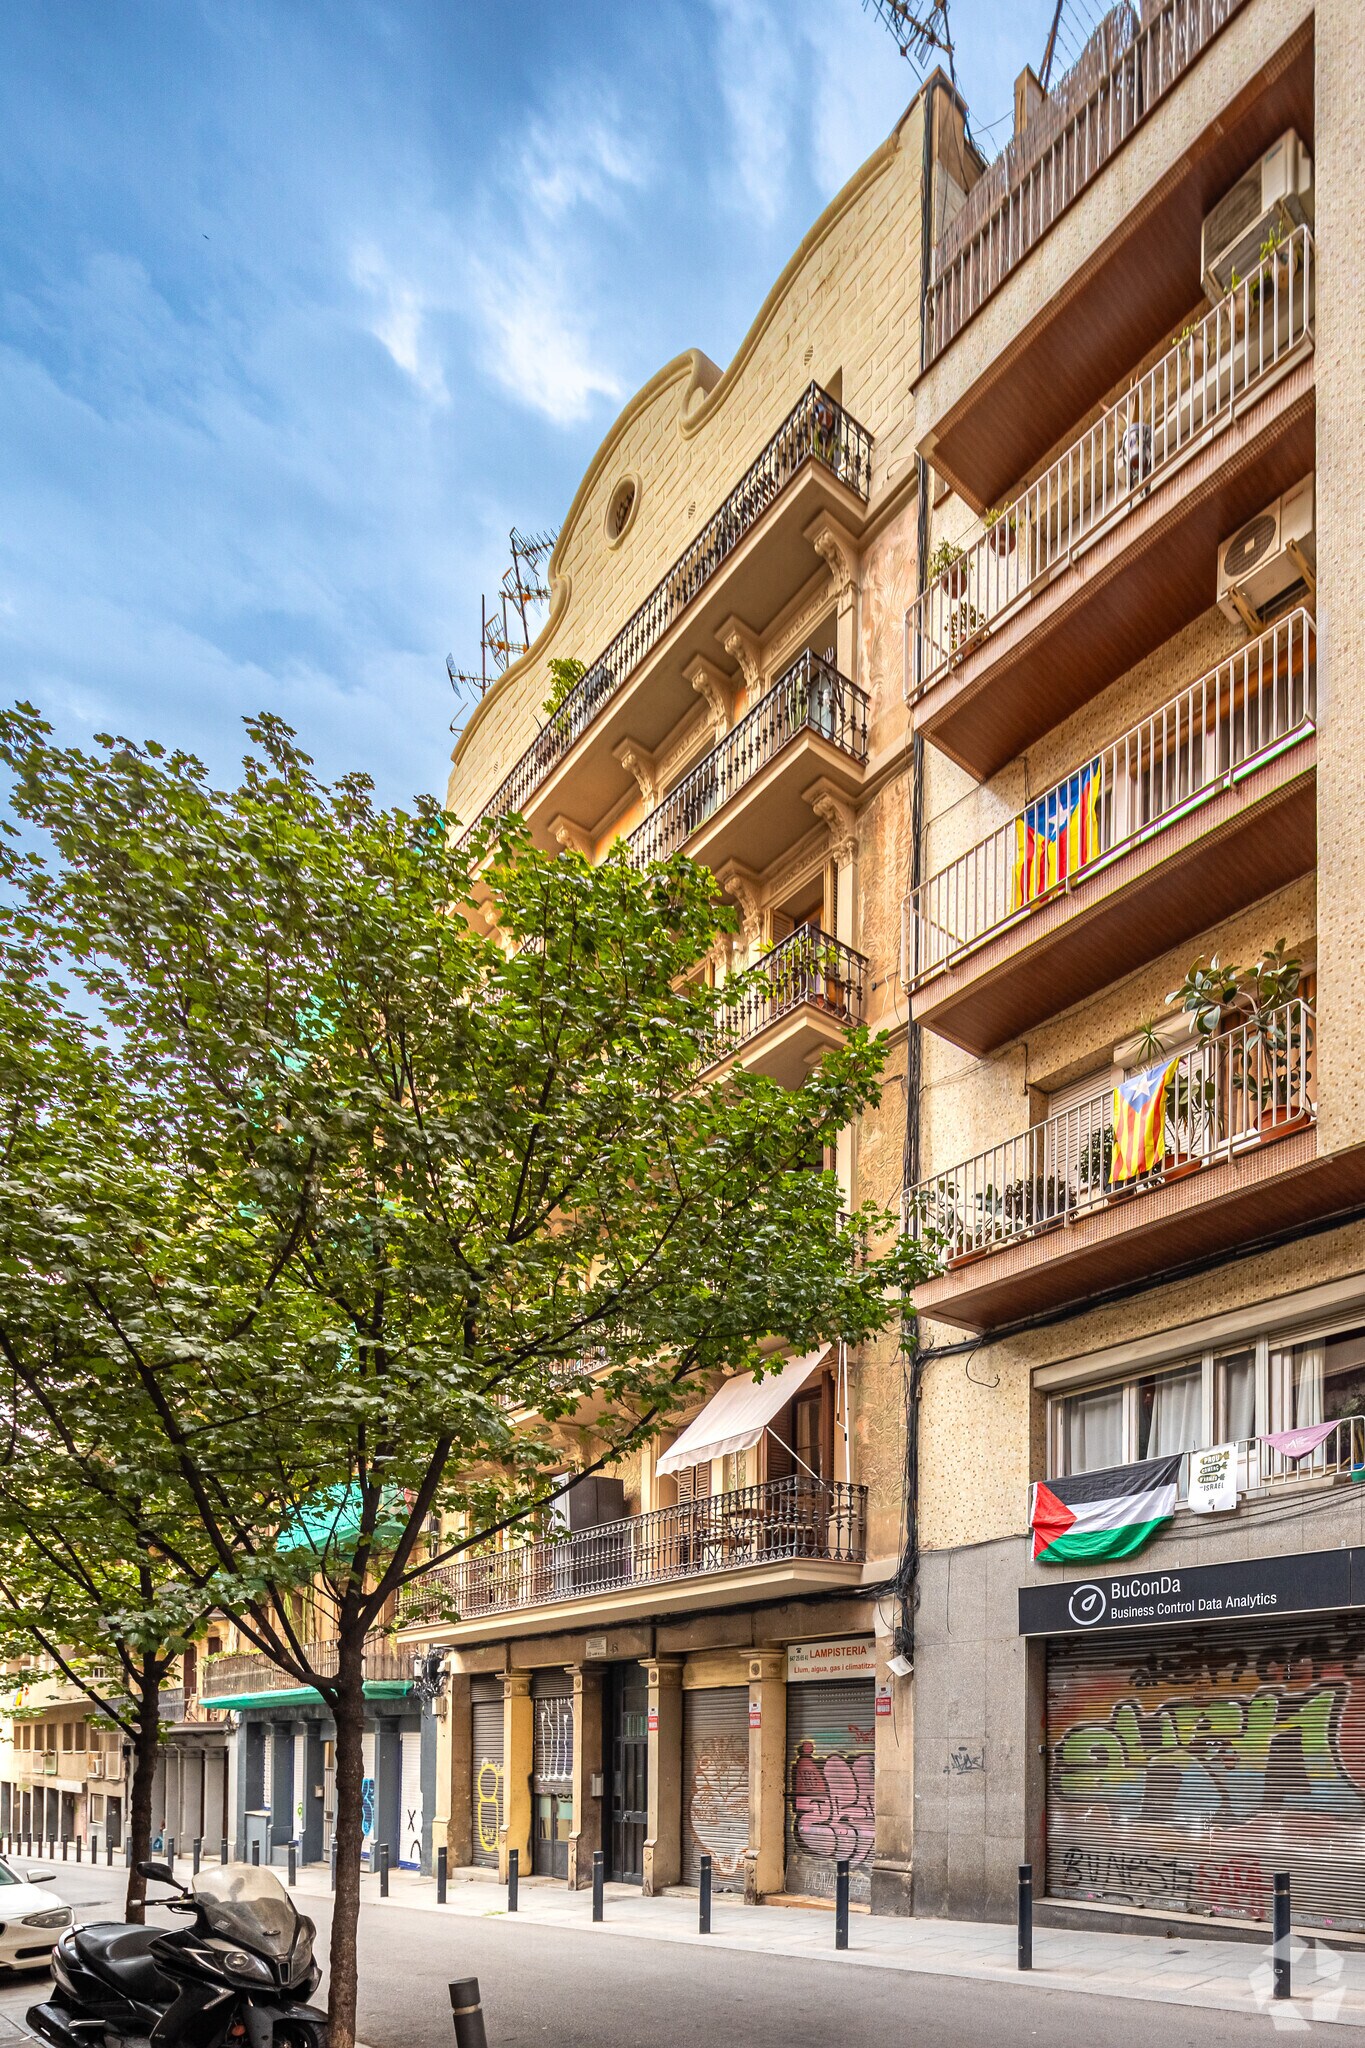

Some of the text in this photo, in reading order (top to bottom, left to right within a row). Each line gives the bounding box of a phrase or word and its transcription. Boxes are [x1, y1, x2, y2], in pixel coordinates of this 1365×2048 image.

[1203, 1482, 1224, 1491] ISRAEL
[1111, 1576, 1181, 1599] BuConDa
[1111, 1592, 1277, 1619] Business Control Data Analytics
[809, 1645, 867, 1658] LAMPISTERIA
[829, 1665, 840, 1673] gas
